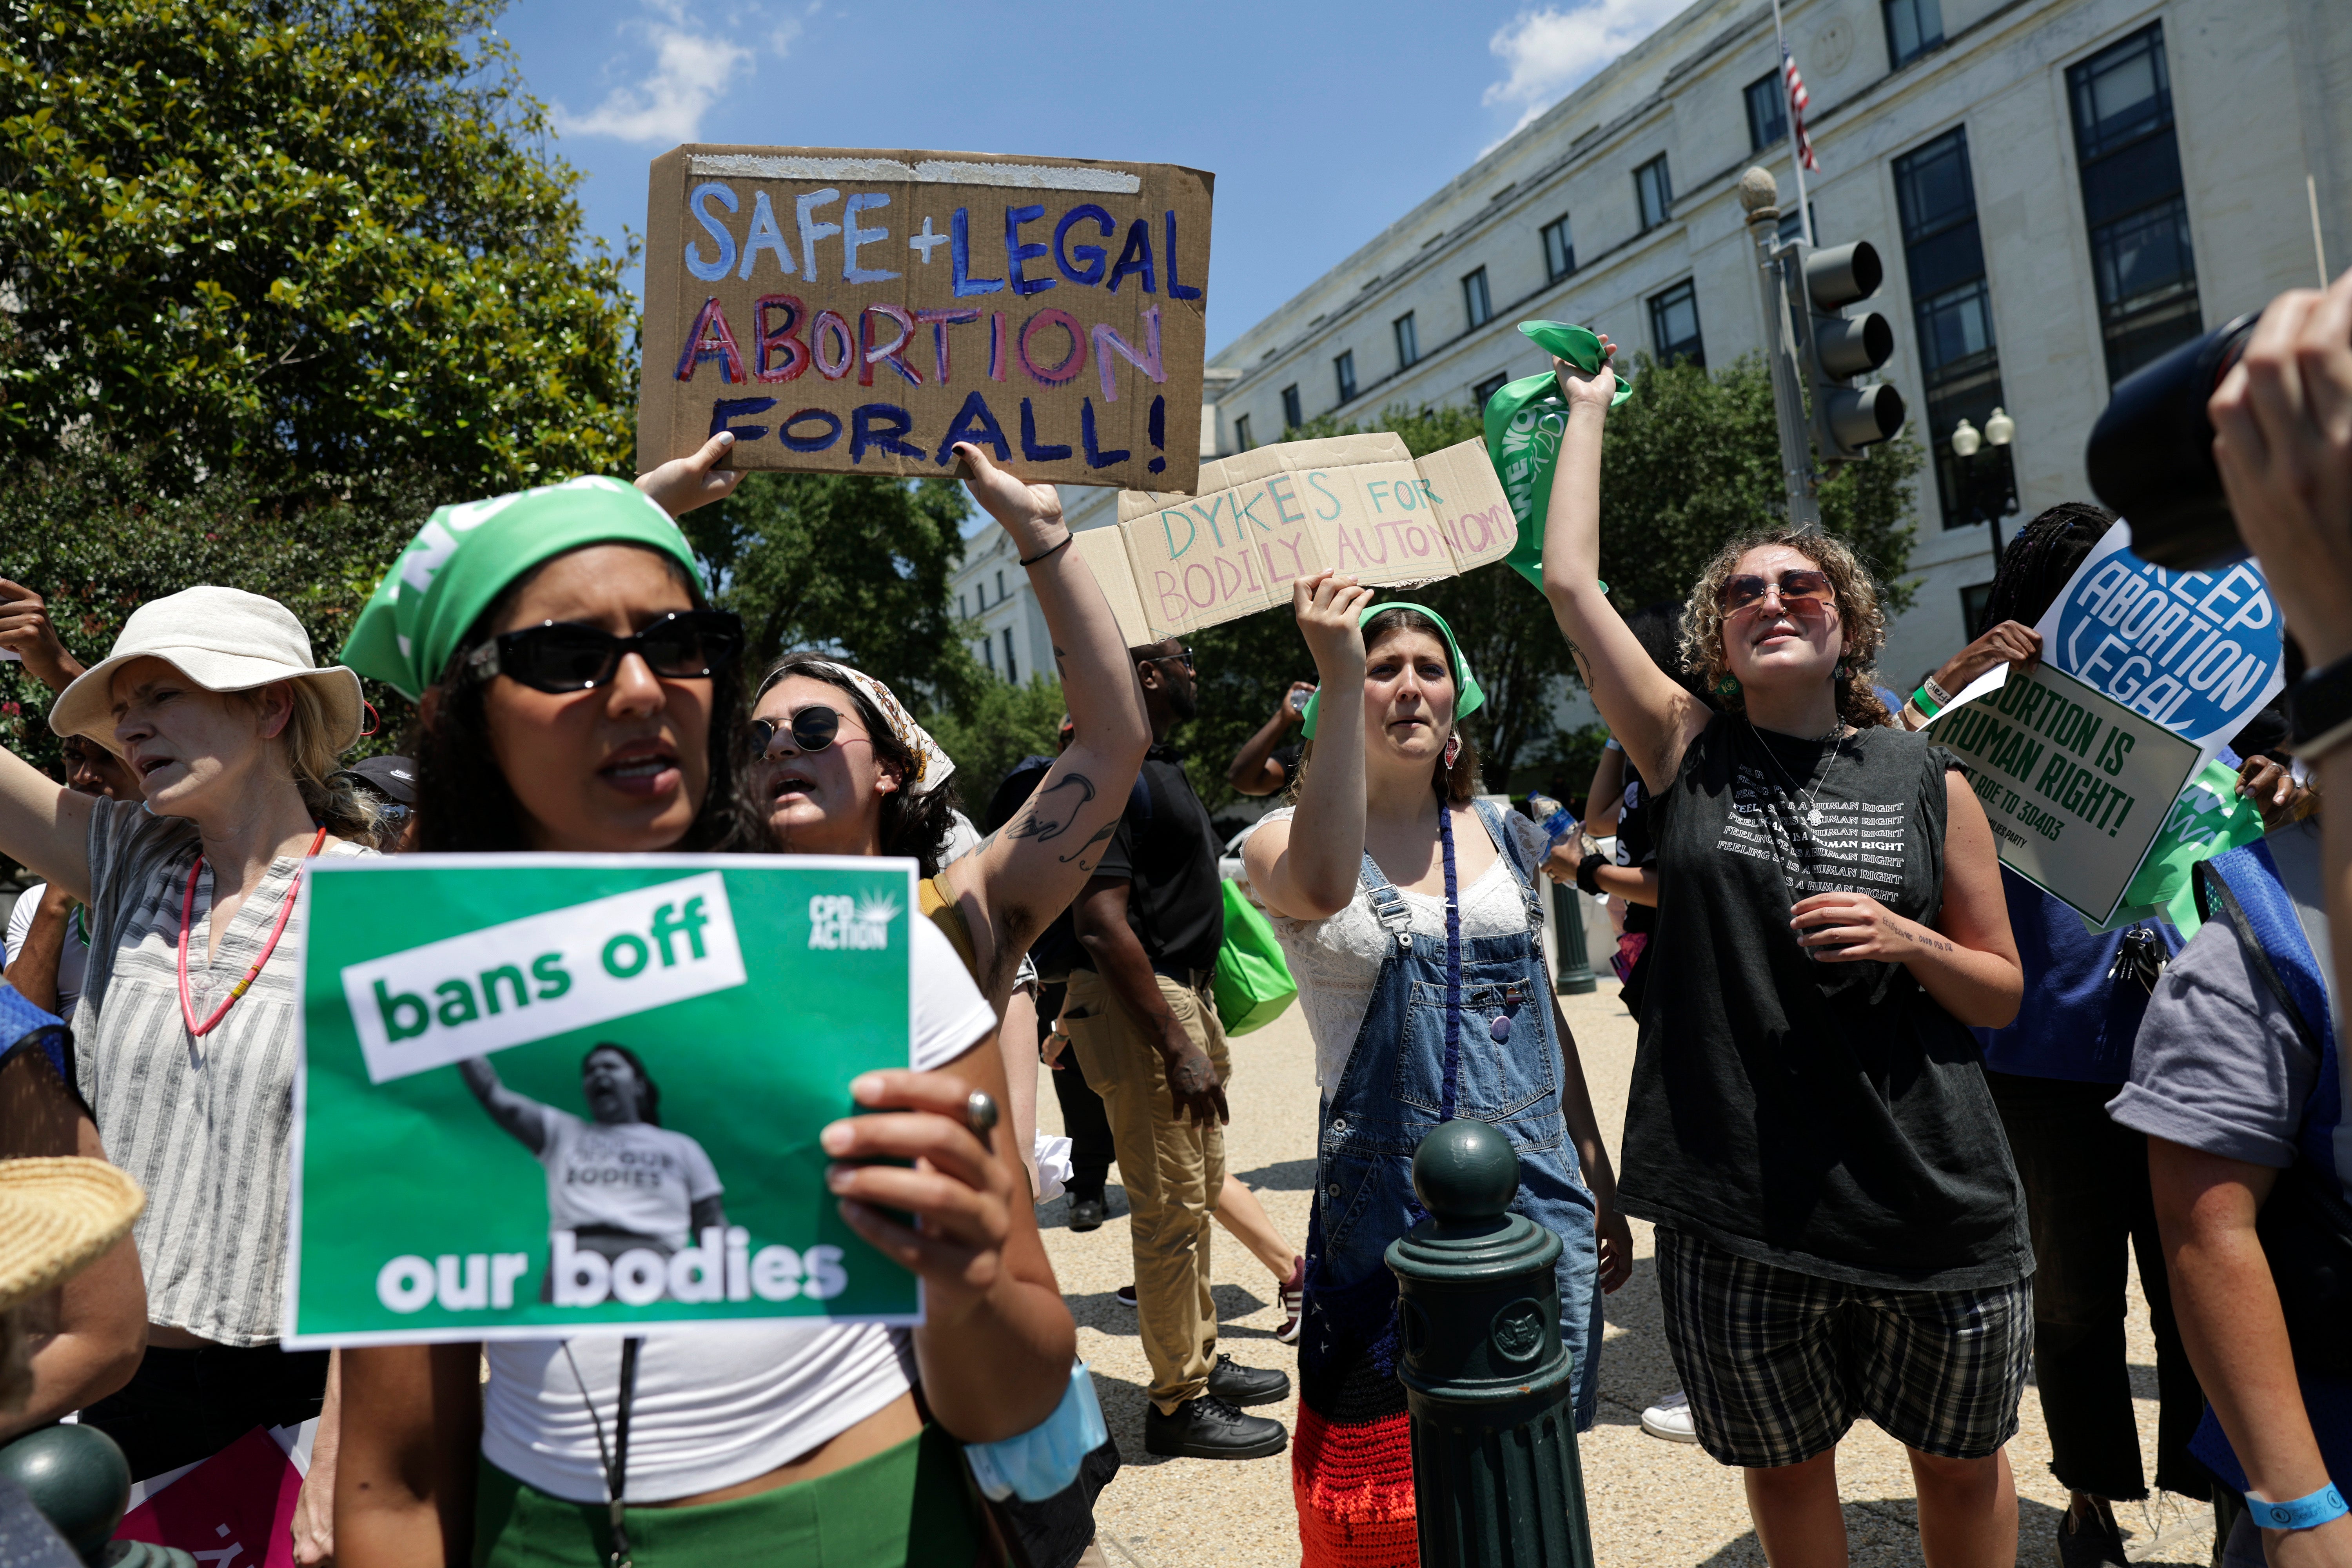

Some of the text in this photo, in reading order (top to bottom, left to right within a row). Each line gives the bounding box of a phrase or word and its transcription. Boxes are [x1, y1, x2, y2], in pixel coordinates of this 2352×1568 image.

[684, 181, 902, 284] SAFE
[950, 204, 1202, 300] LEGAL
[673, 293, 1168, 402] ABORTION
[709, 391, 1165, 474] FOR ALL!
[1160, 471, 1444, 561] DYKES FOR
[1154, 499, 1518, 623] BODILY AUTONOMY
[2077, 560, 2267, 712] ABORTION
[2068, 615, 2196, 731] LEGAL
[1939, 706, 2045, 783] HUMAN
[2034, 752, 2135, 837] RIGHT!
[2094, 726, 2135, 777] IS
[1798, 802, 1808, 810] A
[1813, 802, 1859, 810] HUMAN
[1862, 802, 1904, 813] RIGHT
[1811, 828, 1904, 838] HUMAN RIGHT
[1821, 815, 1858, 824] UMAN
[1861, 816, 1904, 825] RIGHT
[1973, 774, 2004, 804] ROE
[2000, 789, 2020, 815] TO
[2016, 801, 2065, 841] 30403
[1717, 840, 1770, 860] FEELING
[1795, 880, 1804, 889] A
[1807, 881, 1853, 893] HUMAN
[1811, 834, 1858, 848] HUMAN
[1861, 842, 1904, 851] RIGHT
[1811, 848, 1858, 861] HUMAN
[1861, 854, 1904, 867] RIGHT
[2004, 829, 2027, 848] PARTY
[1786, 860, 1800, 872] IS
[1802, 865, 1810, 874] A
[1812, 864, 1857, 878] HUMAN
[1860, 869, 1903, 885] RIGHT
[808, 920, 888, 951] ACTION
[809, 894, 855, 922] CPD
[372, 895, 709, 1044] bans off
[376, 1226, 848, 1314] our bodies
